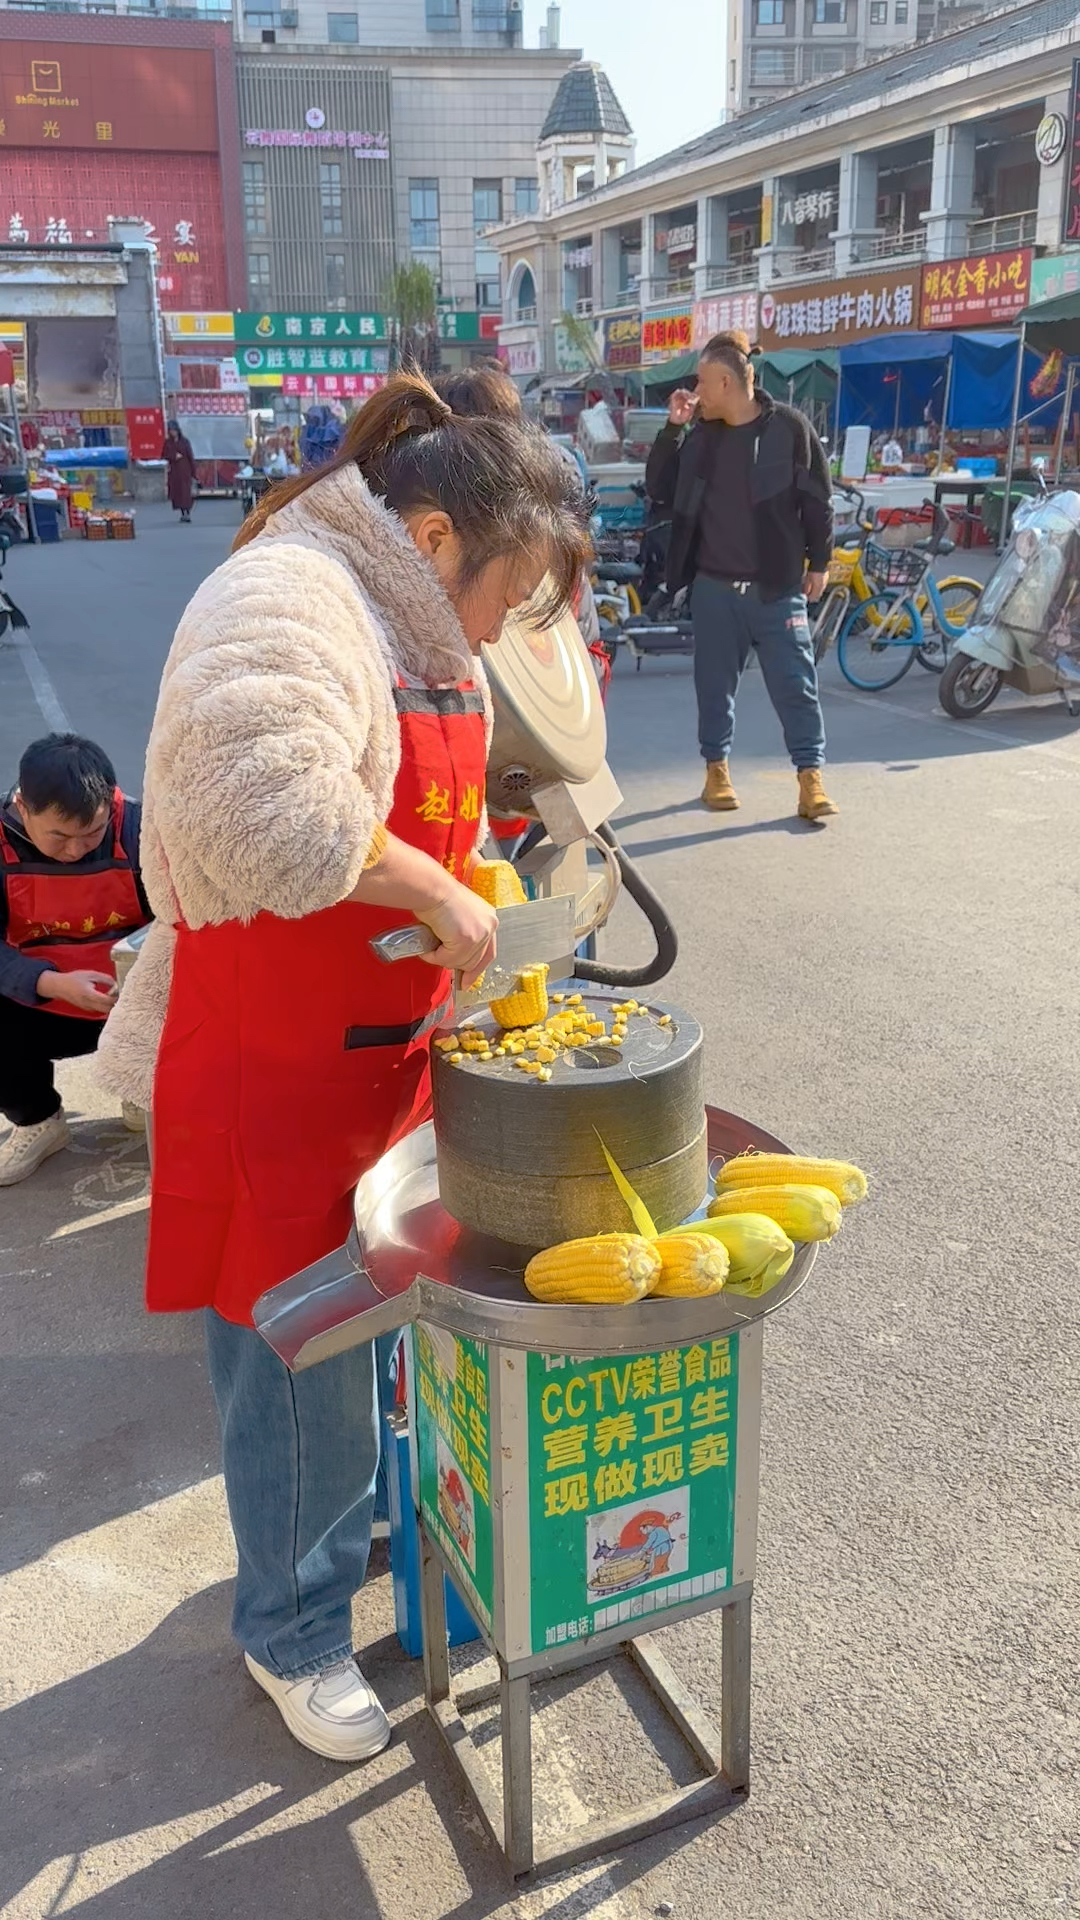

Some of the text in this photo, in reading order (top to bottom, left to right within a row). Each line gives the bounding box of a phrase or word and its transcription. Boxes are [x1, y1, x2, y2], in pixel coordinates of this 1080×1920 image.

[49, 96, 79, 107] Market
[174, 251, 200, 264] YAN
[541, 1337, 732, 1425] CCTV荣誉食品
[543, 1386, 730, 1472] 营养卫生
[543, 1432, 730, 1518] 现做现卖
